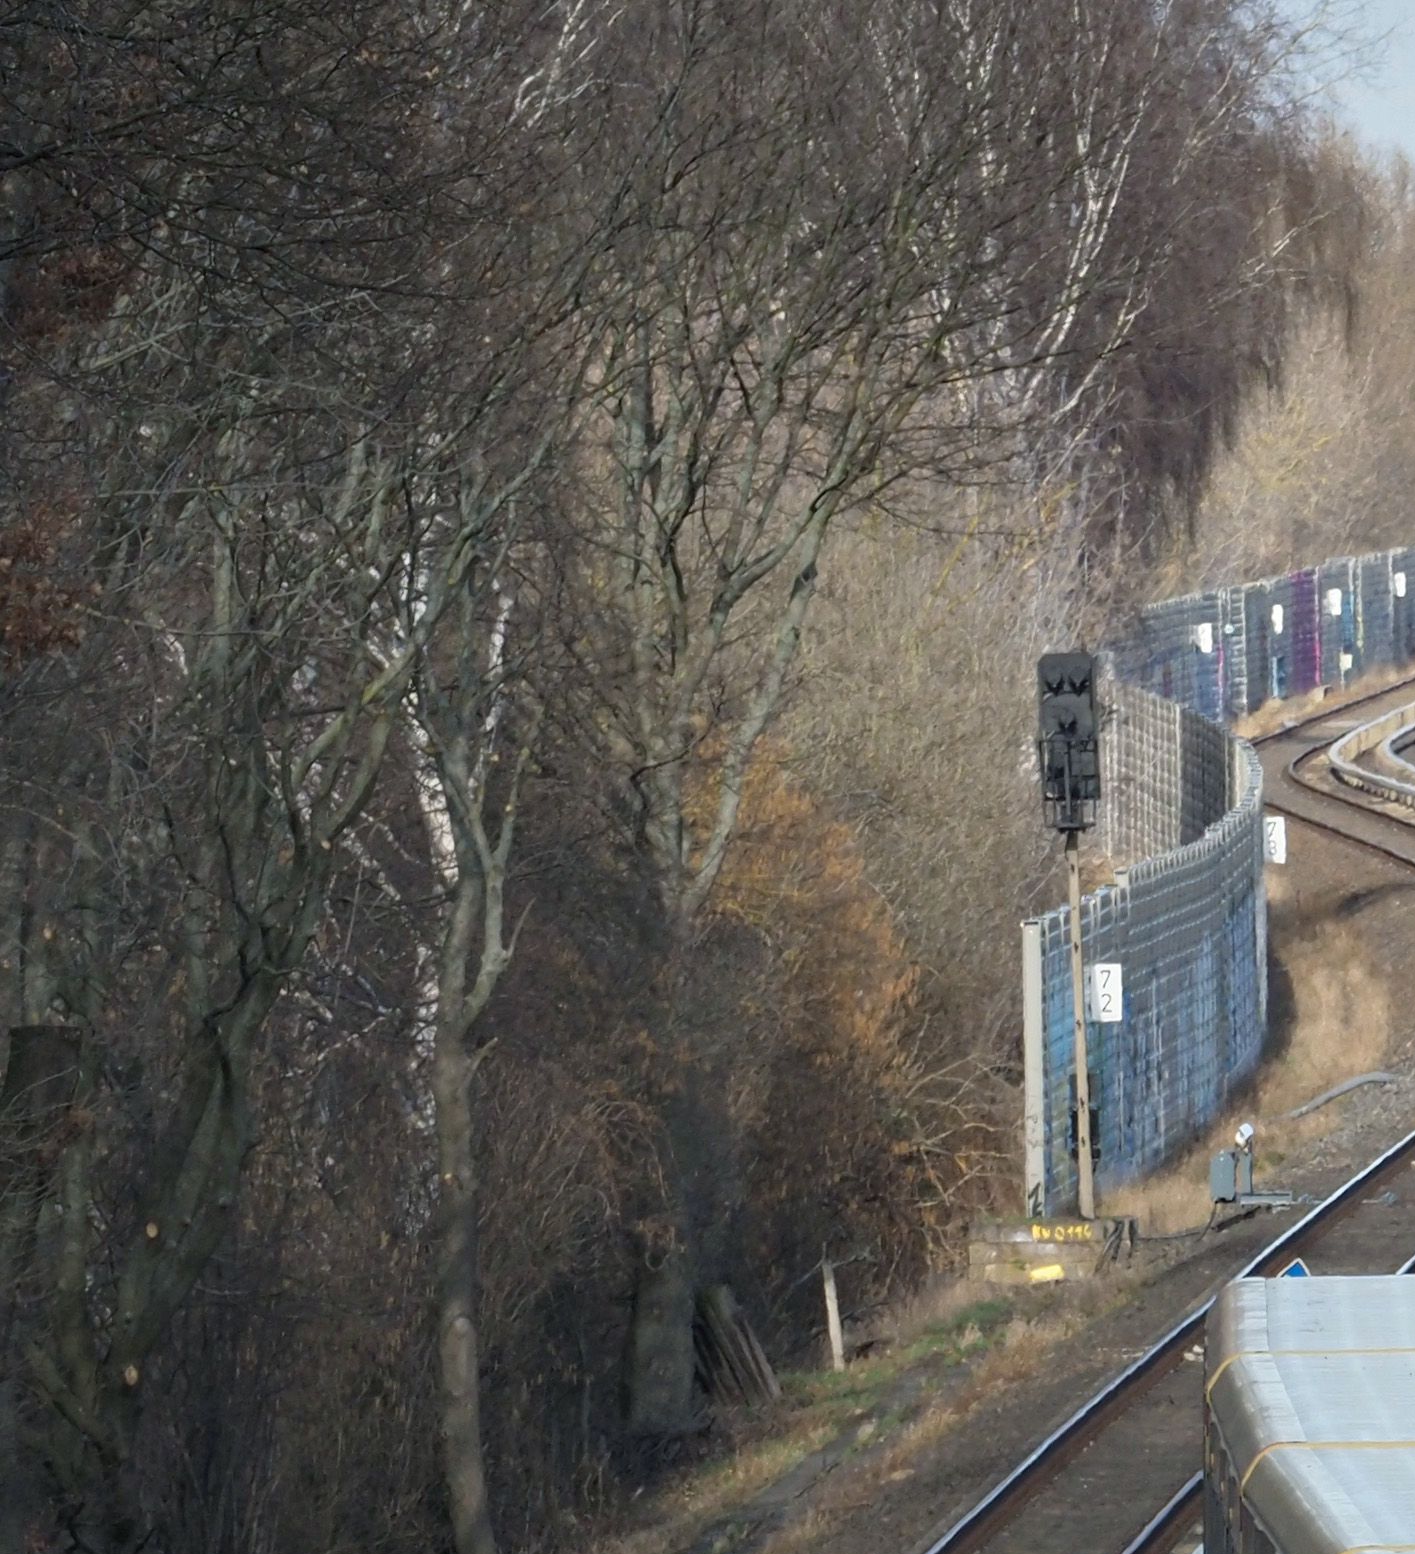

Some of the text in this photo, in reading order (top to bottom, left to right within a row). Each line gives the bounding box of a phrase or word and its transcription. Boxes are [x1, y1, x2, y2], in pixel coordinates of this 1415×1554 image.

[1267, 822, 1277, 838] 7
[1100, 970, 1111, 989] 7
[1101, 993, 1112, 1012] 2
